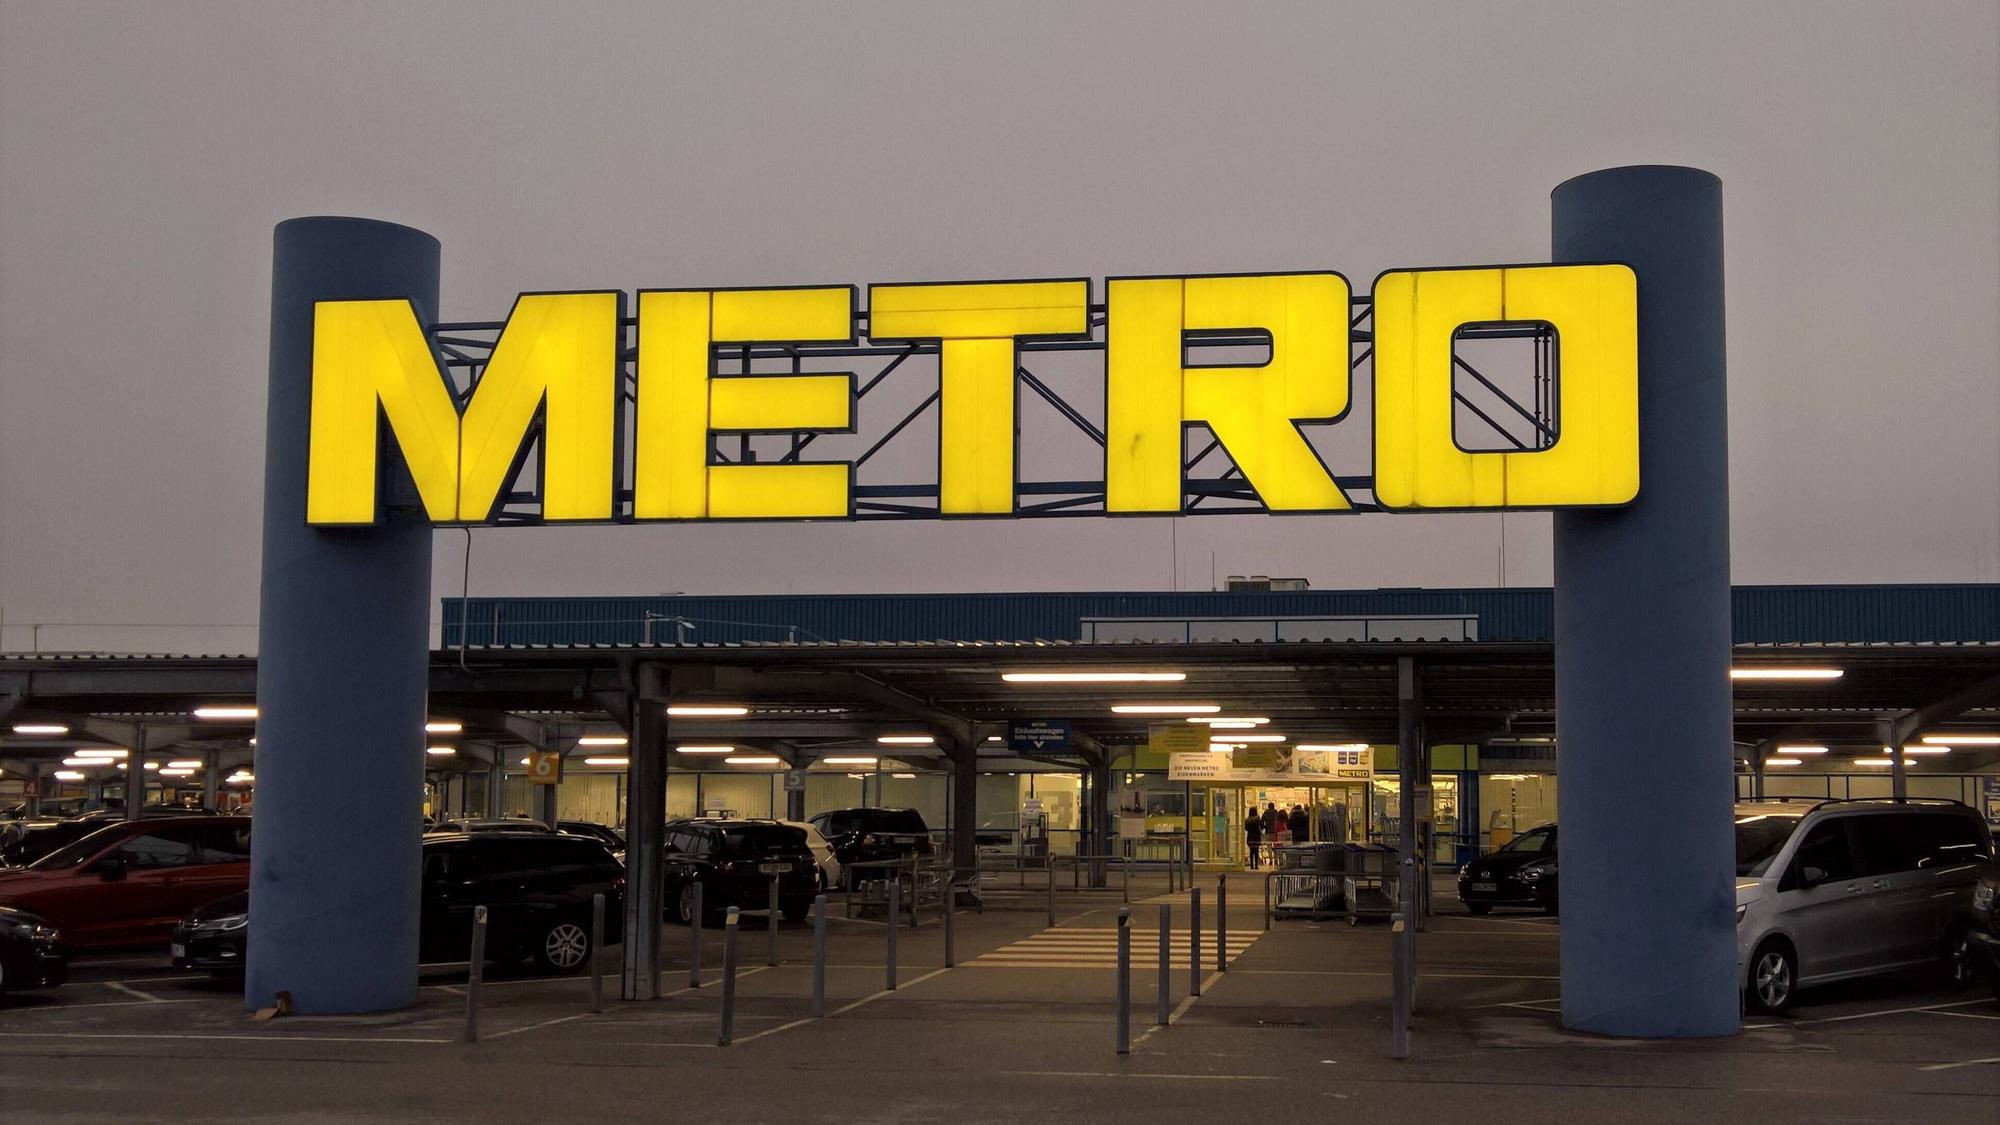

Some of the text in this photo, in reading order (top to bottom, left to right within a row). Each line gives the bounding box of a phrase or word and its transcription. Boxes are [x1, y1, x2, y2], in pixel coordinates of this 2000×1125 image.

[305, 263, 1640, 526] METRO
[535, 754, 552, 776] 6
[789, 769, 801, 786] 5
[26, 782, 36, 793] 4
